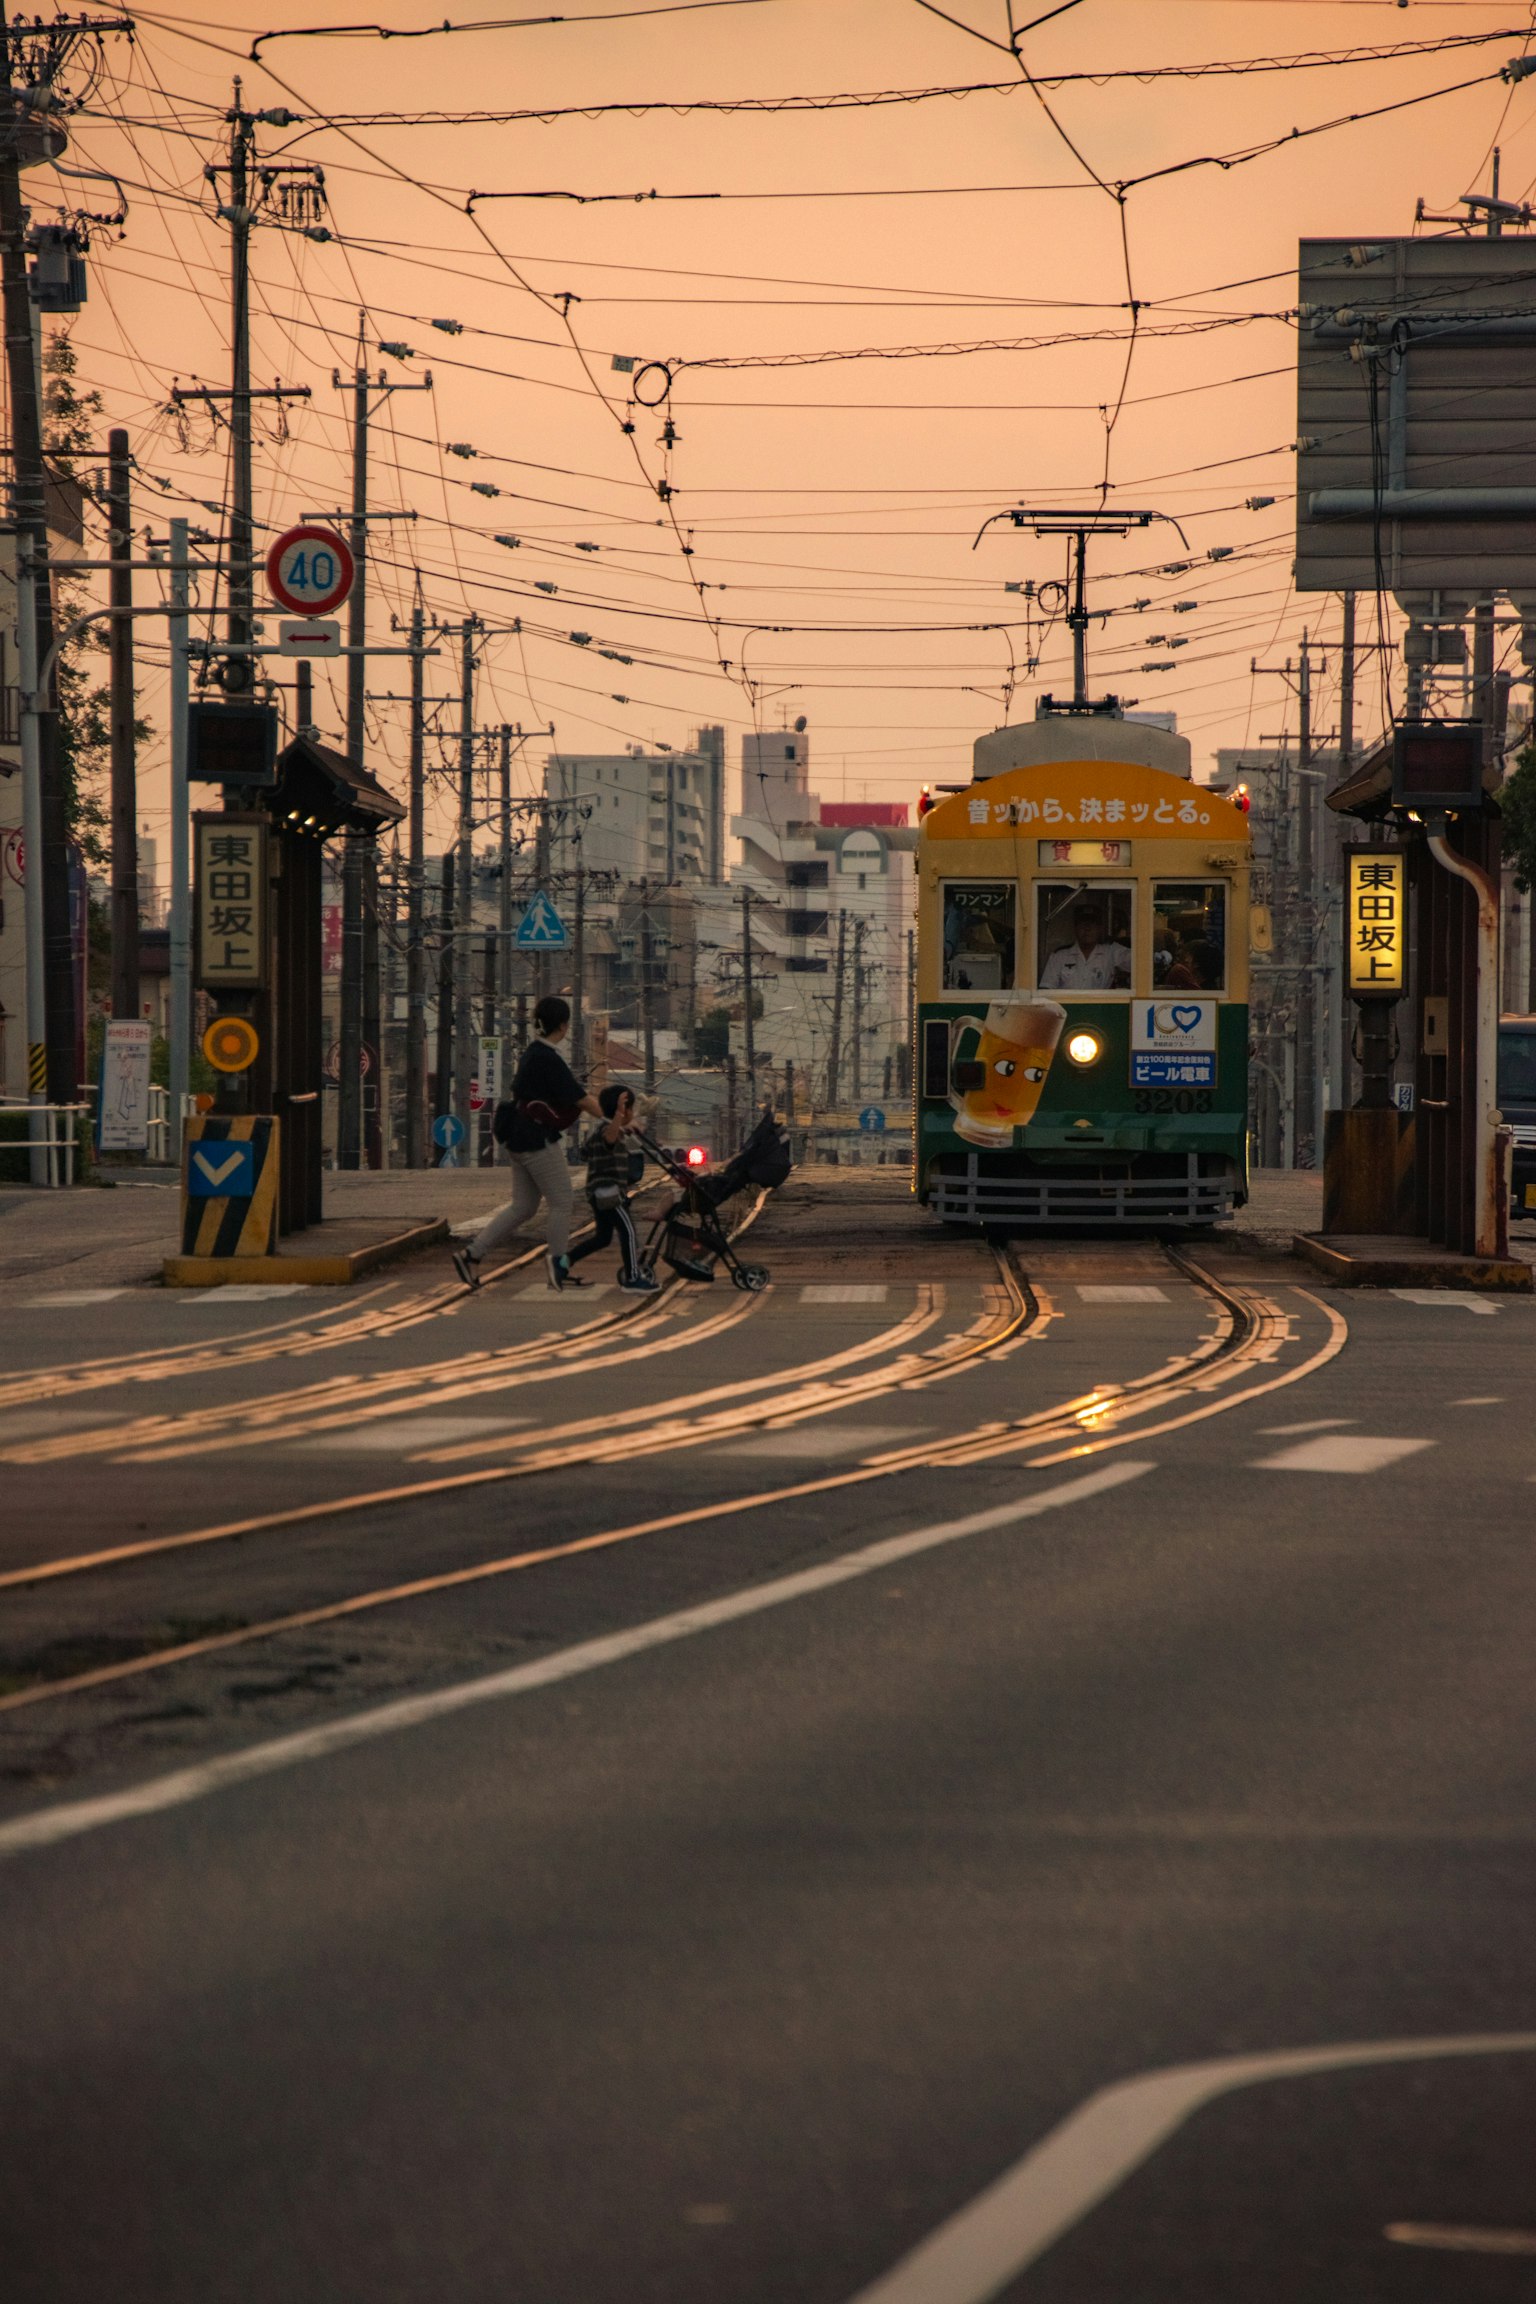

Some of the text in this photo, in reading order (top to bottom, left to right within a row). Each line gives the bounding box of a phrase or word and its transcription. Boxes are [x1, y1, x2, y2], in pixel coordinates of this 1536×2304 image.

[287, 551, 335, 591] 40
[206, 834, 254, 972] 東田坂上
[954, 893, 1005, 906] ワンマン
[1355, 862, 1397, 982] 東田坂上
[1136, 1066, 1210, 1081] ビール電車
[1135, 1088, 1213, 1114] 3203
